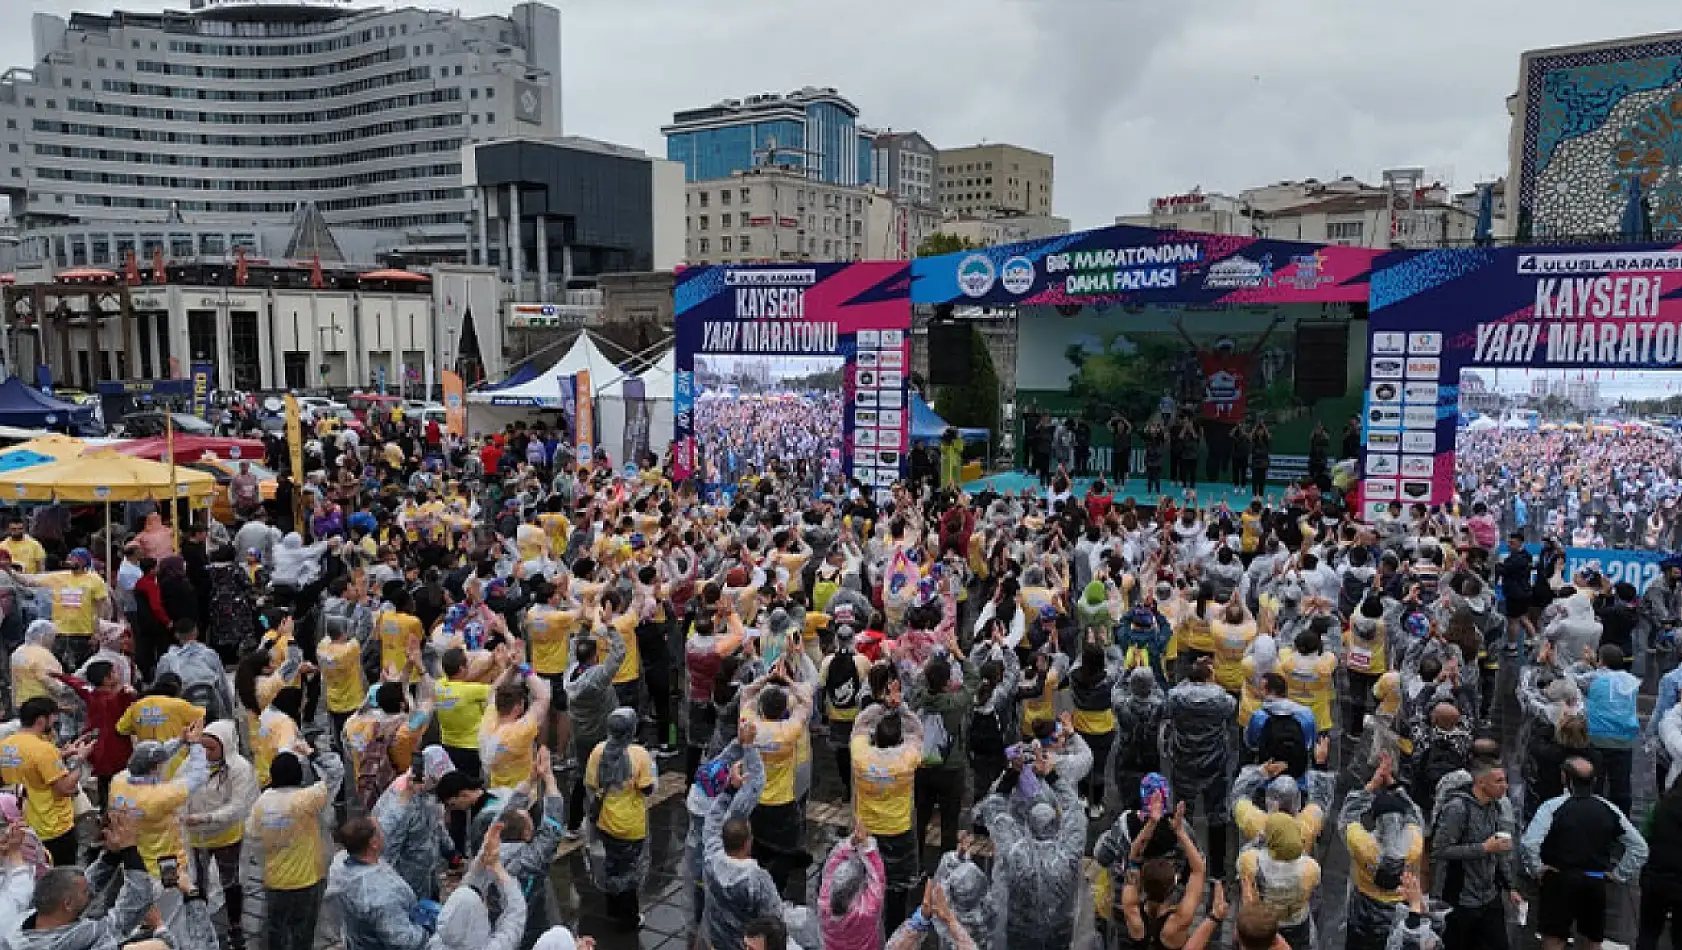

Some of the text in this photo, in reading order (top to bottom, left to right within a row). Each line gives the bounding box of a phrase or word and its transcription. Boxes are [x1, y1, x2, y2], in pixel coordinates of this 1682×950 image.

[1074, 243, 1198, 269] MARATONDAN
[1066, 268, 1177, 293] DAHA FAZLASI
[702, 321, 838, 351] YARI MARATONU
[1472, 322, 1542, 362] YARI
